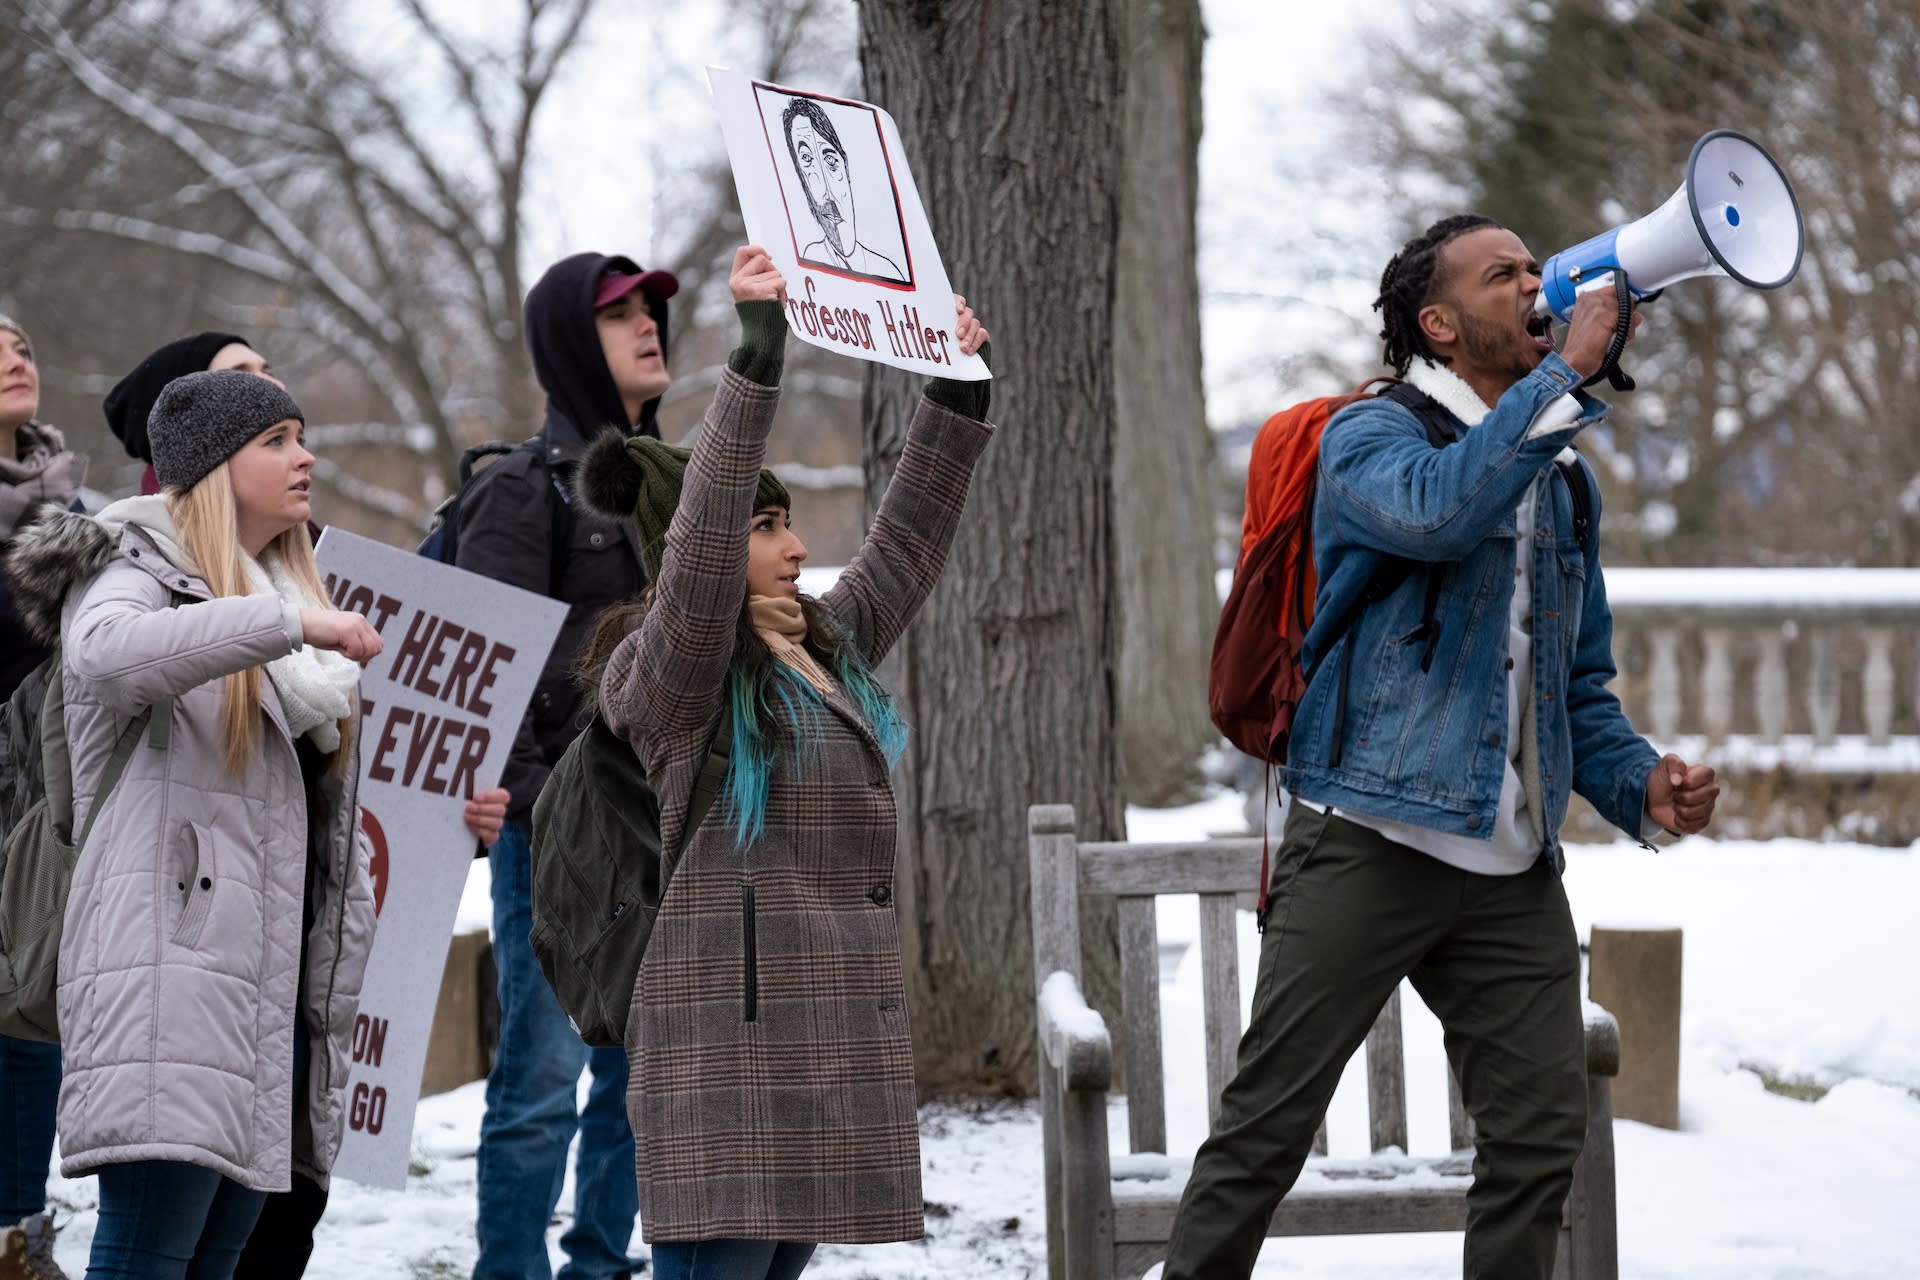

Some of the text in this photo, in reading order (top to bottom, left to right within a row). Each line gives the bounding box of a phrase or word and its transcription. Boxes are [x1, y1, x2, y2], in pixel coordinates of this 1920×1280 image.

[783, 276, 951, 365] rofessor Hitler
[388, 609, 516, 719] HERE
[368, 706, 491, 800] EVER
[349, 1082, 387, 1135] GO
